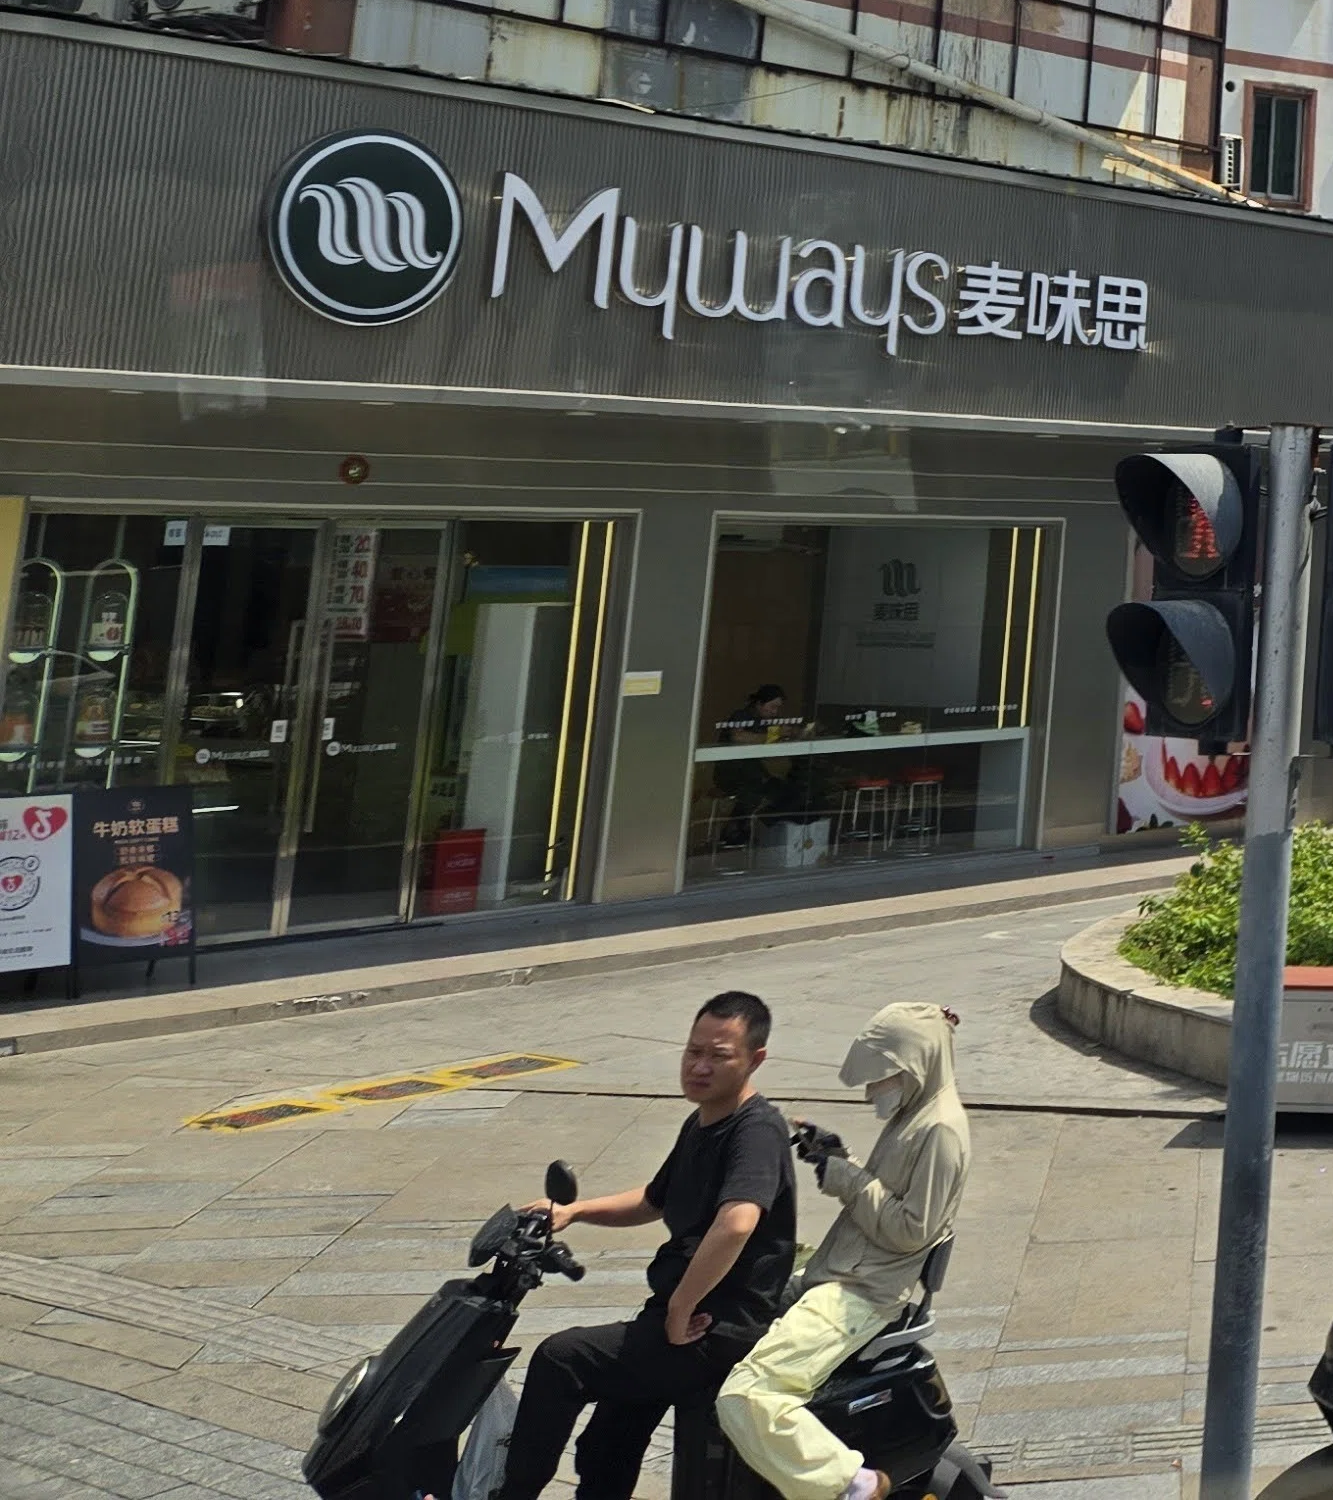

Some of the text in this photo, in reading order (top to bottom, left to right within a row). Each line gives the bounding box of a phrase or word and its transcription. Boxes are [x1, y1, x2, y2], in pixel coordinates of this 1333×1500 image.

[489, 170, 1150, 357] Myways 麦味思
[92, 816, 180, 838] 牛奶软蛋糕
